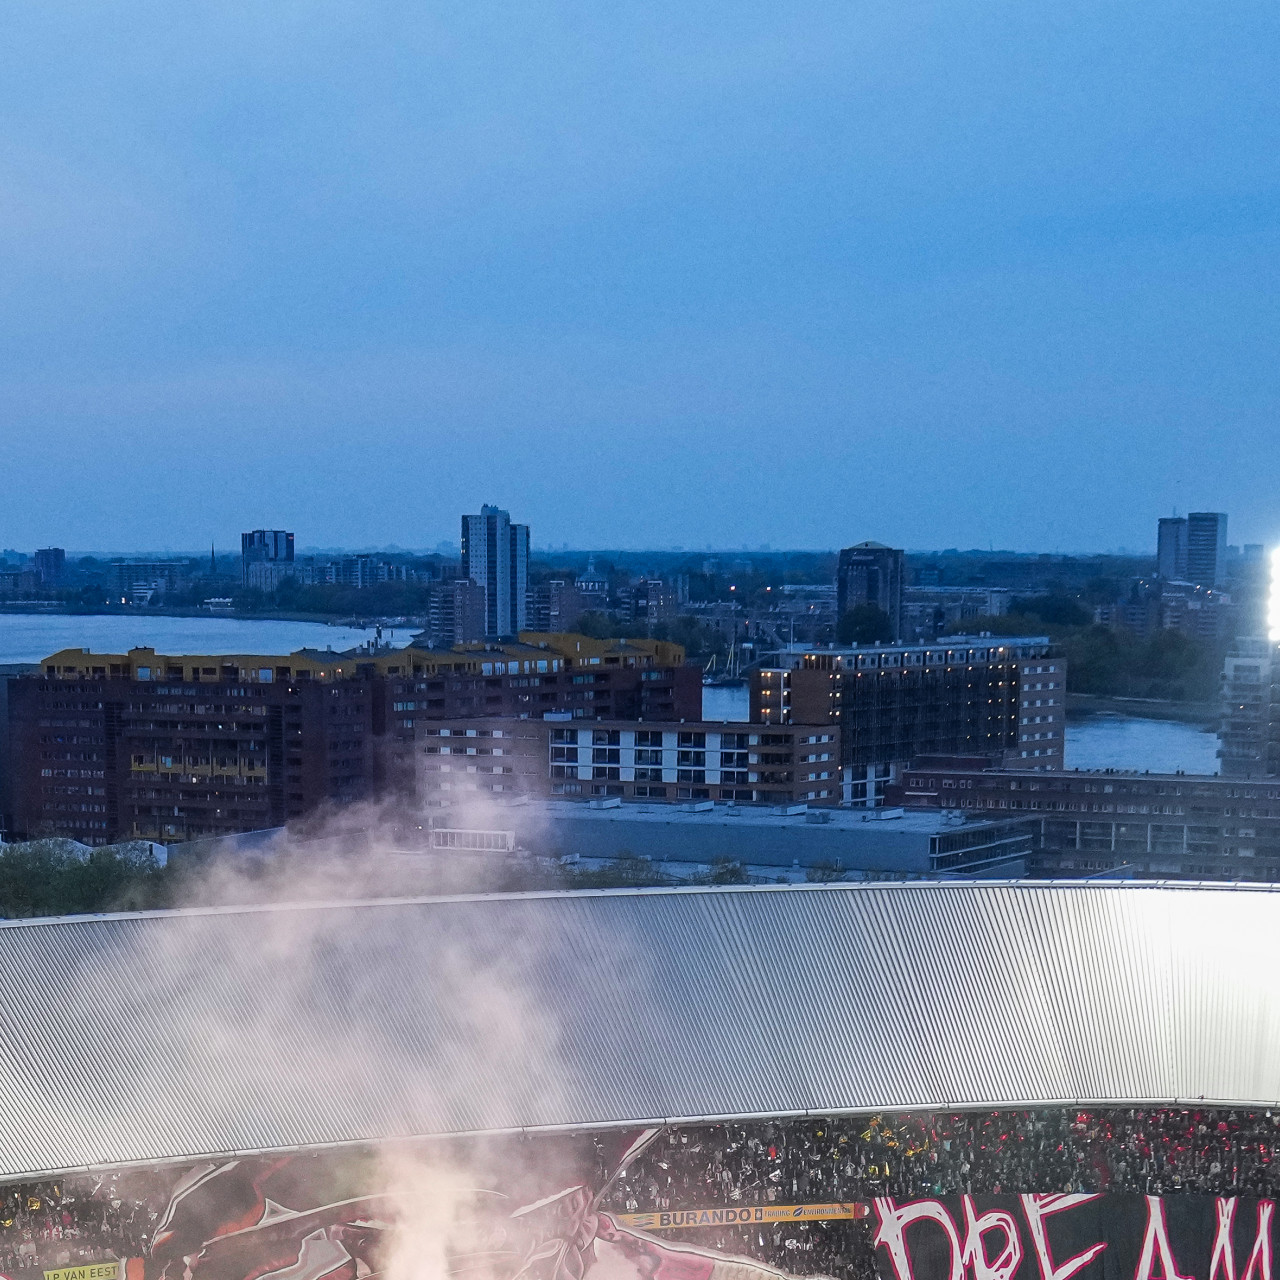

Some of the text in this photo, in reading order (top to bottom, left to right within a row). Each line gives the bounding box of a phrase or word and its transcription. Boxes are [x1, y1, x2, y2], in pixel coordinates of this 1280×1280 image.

[659, 1209, 751, 1227] BURANDO
[64, 1269, 86, 1280] VAN
[89, 1265, 119, 1278] EEST
